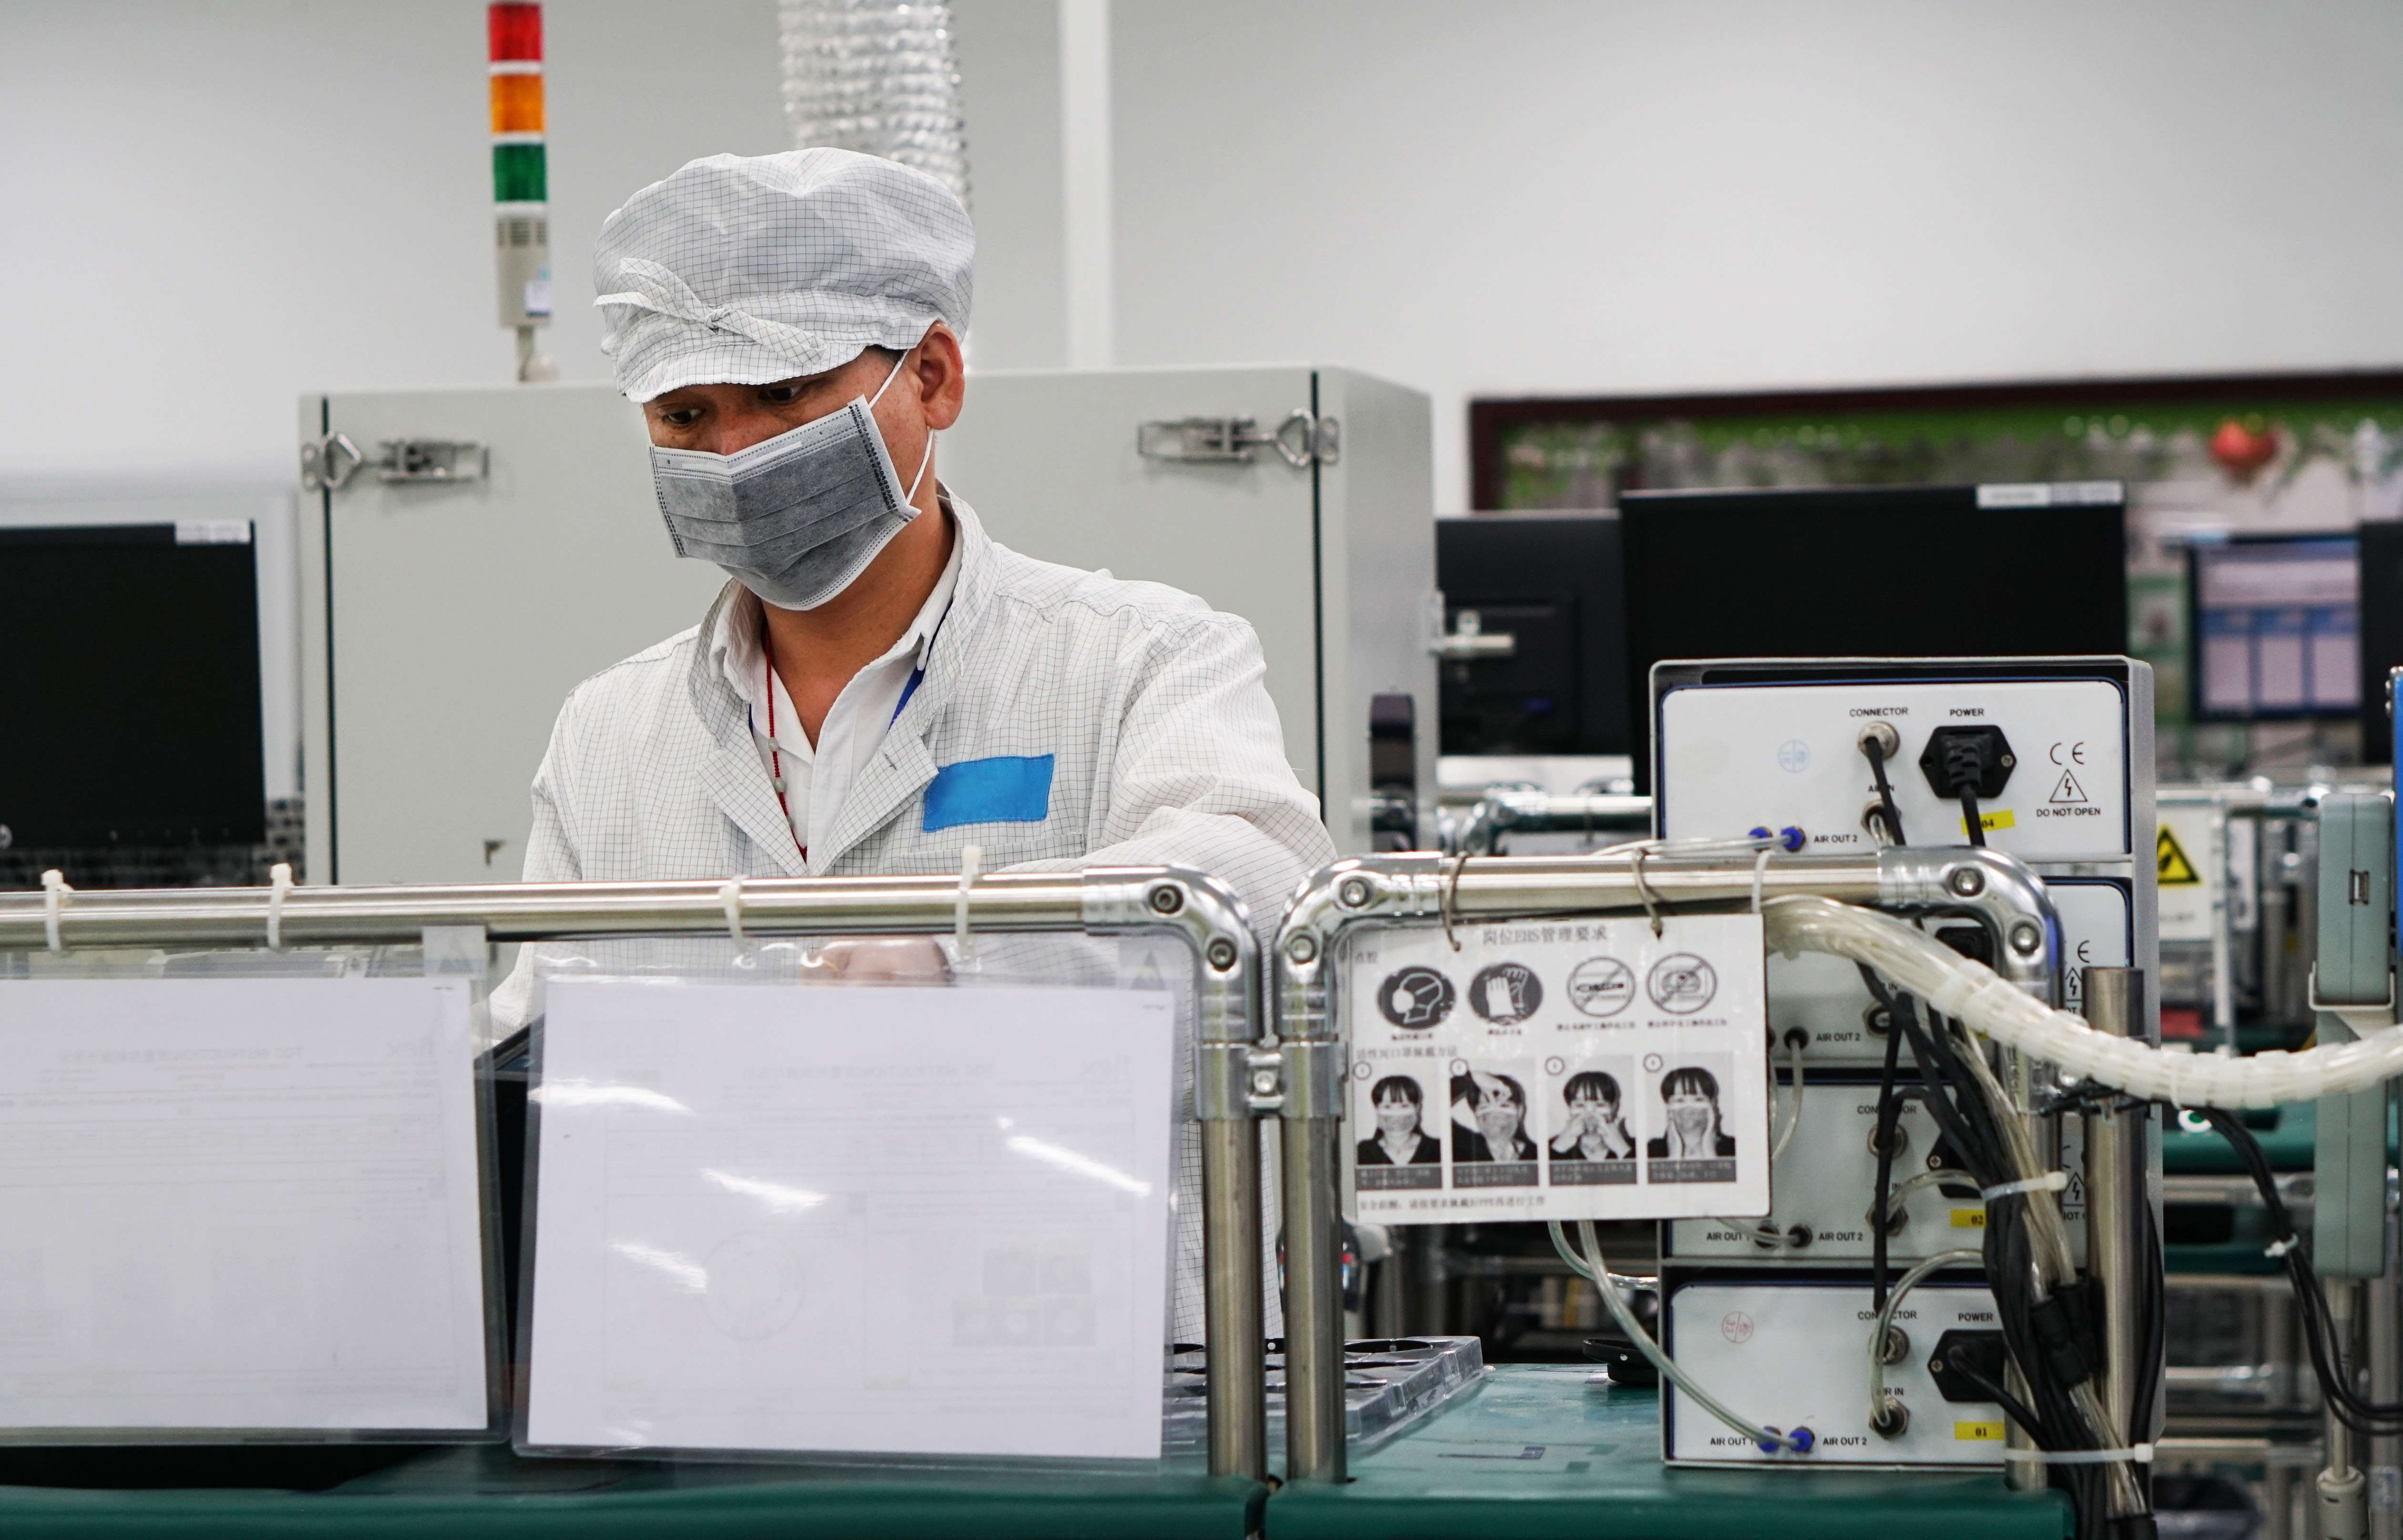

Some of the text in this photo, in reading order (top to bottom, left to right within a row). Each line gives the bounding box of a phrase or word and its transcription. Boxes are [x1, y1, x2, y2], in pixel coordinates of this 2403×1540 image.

[1850, 707, 1908, 717] CONNECTOR
[1950, 708, 1984, 717] POWER
[2050, 742, 2085, 765] CE
[2036, 807, 2101, 817] DO NOT OPEN
[1831, 835, 1850, 843] OUT
[1852, 834, 1858, 842] 2
[1816, 1032, 1860, 1042] AIR OUT 2
[1706, 1232, 1721, 1240] AIR
[1818, 1232, 1863, 1240] AIR OUT 2
[1958, 1312, 1993, 1322] POWER
[1894, 1387, 1904, 1396] IN
[1975, 1427, 1987, 1437] 01
[1710, 1437, 1725, 1446] AIR
[1728, 1437, 1746, 1446] OUT
[1823, 1437, 1867, 1446] AIR OUT 2
